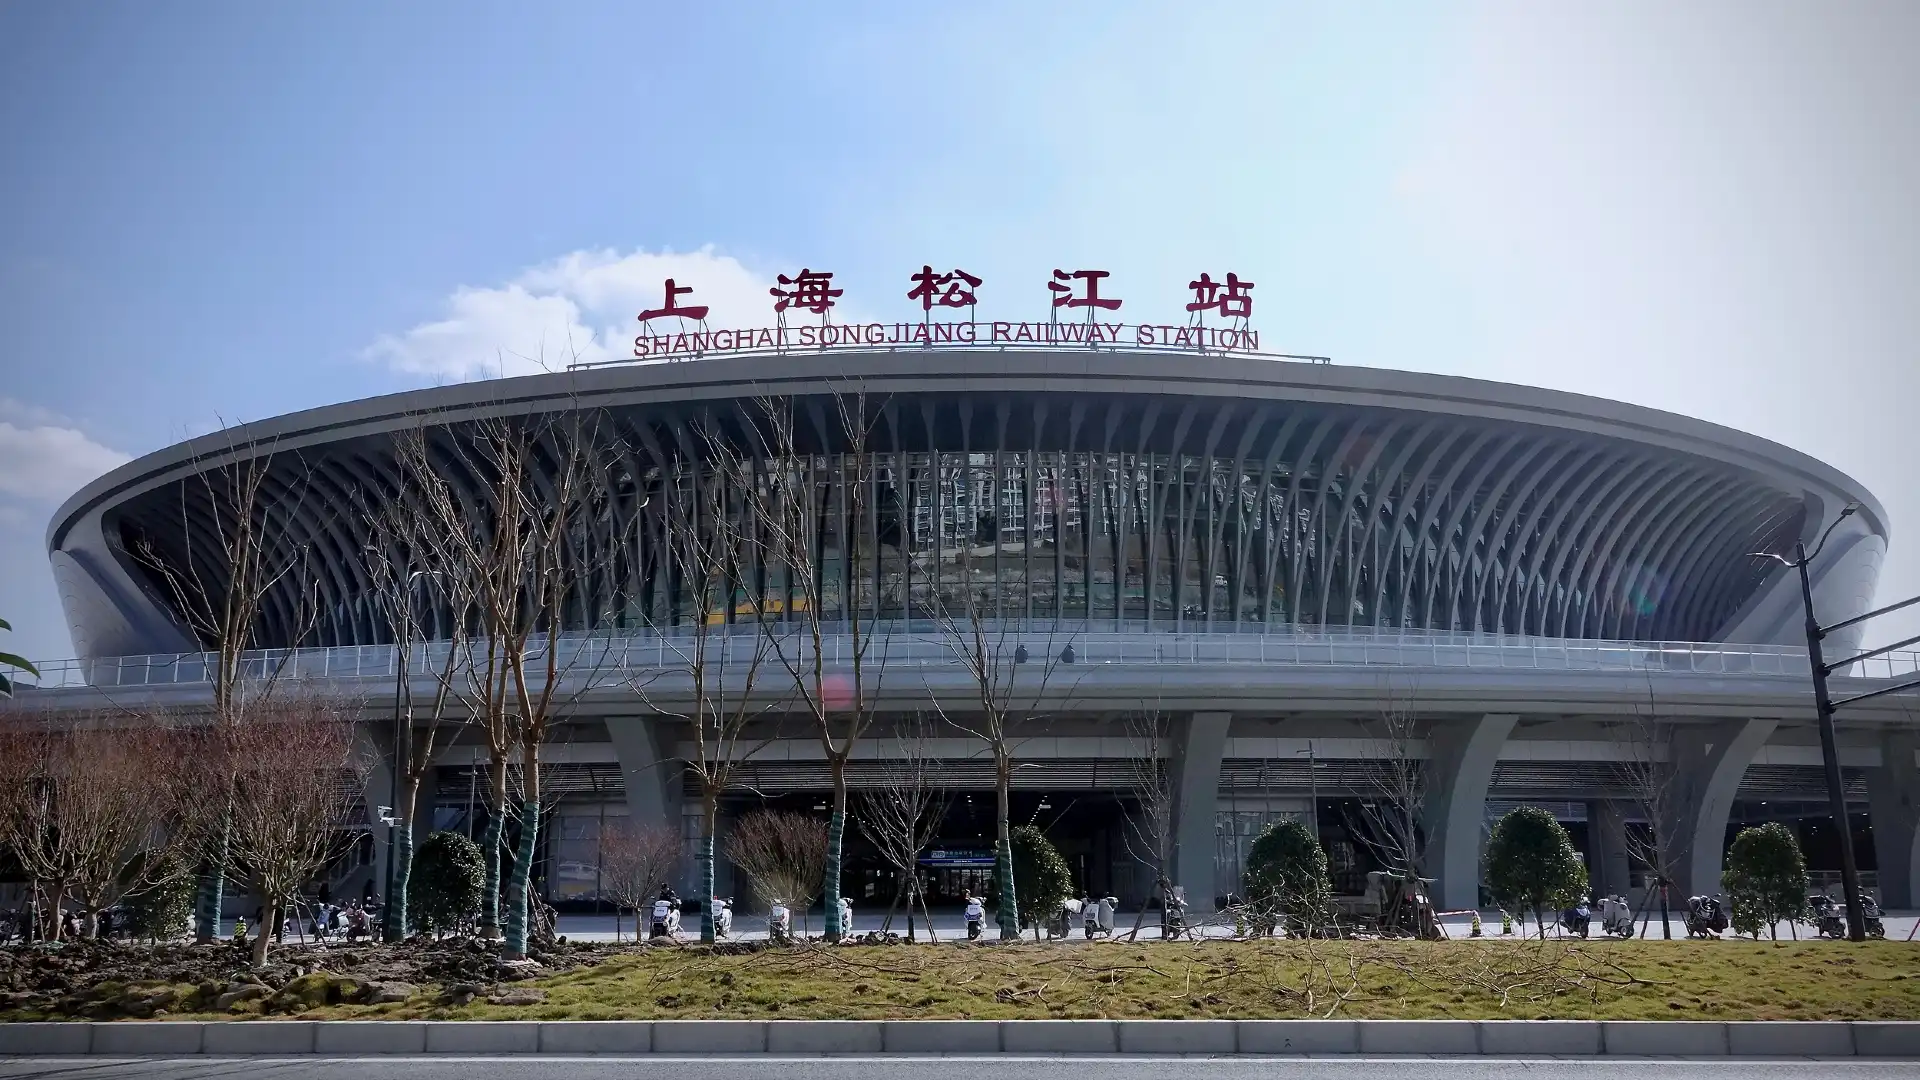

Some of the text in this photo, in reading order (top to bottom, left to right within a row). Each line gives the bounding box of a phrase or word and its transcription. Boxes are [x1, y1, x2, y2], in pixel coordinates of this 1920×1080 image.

[637, 265, 1255, 317] 上海松江站
[634, 321, 1258, 356] SHANGHAI SONGJIANG RAILWAY STATION
